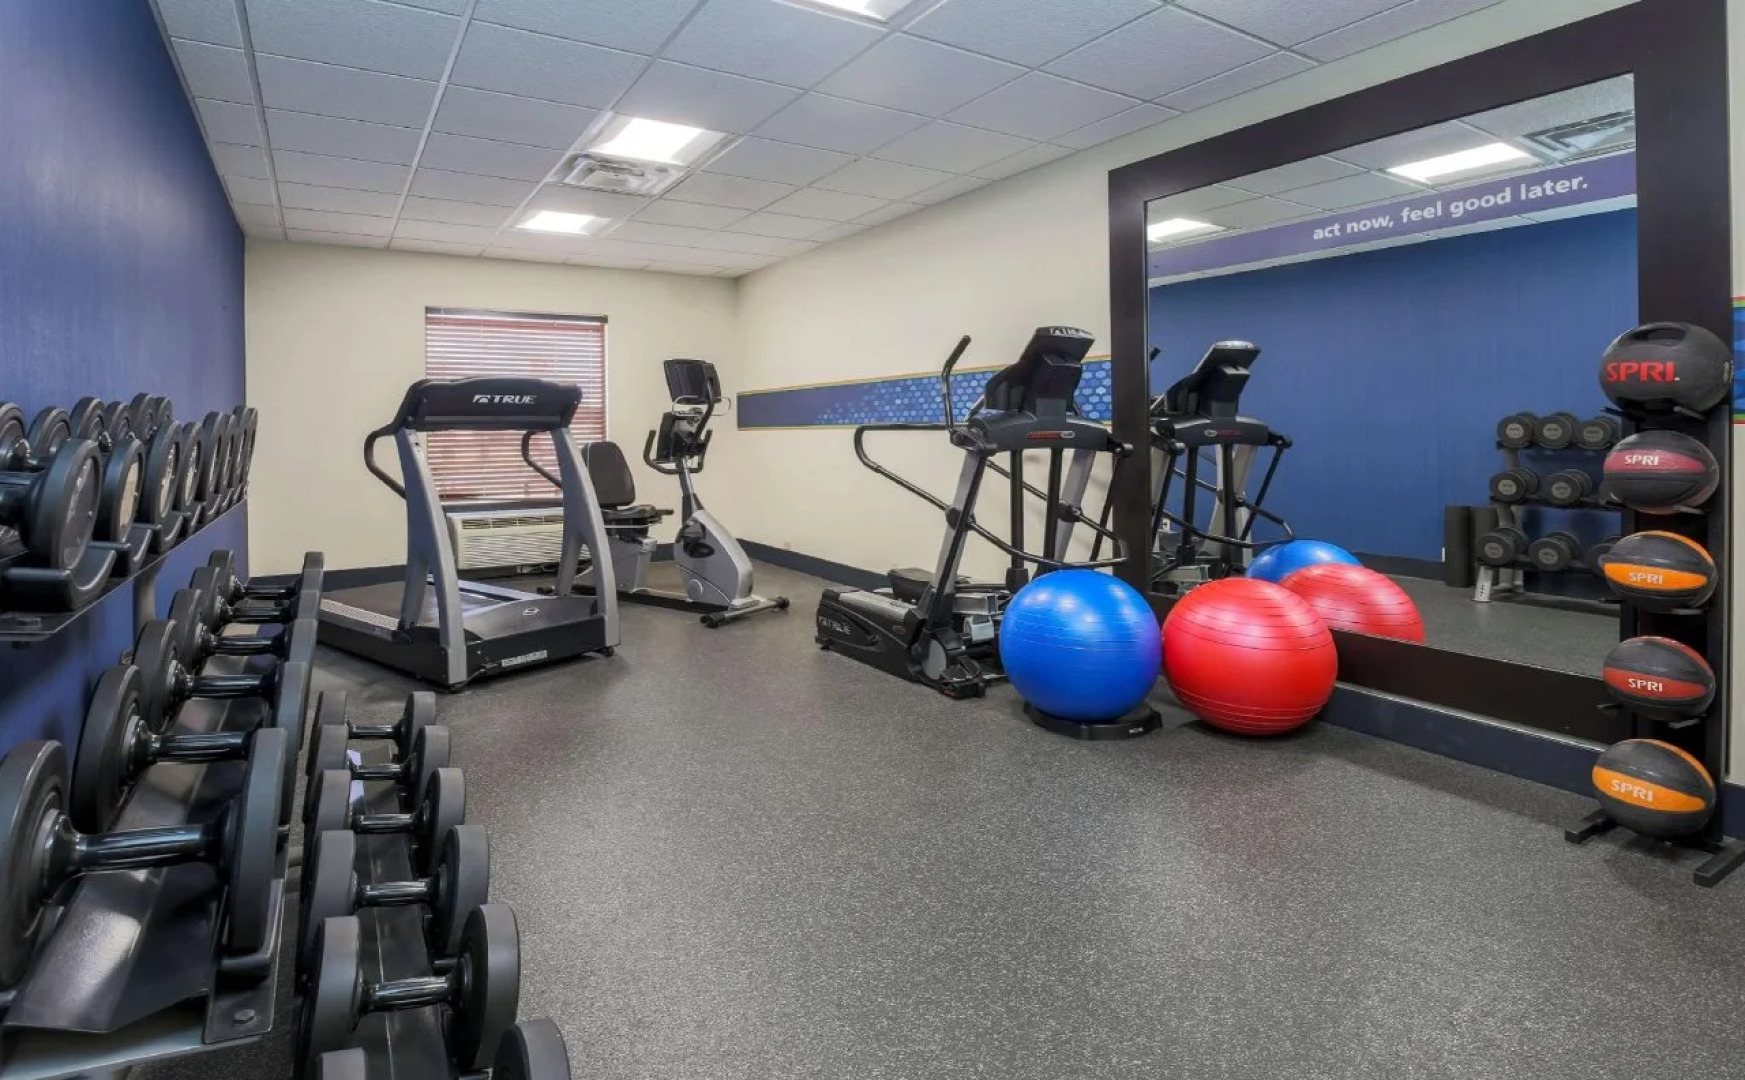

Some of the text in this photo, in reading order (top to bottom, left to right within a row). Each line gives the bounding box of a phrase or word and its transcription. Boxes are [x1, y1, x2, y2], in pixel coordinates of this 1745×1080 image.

[1313, 176, 1588, 240] act now, feel good later.
[492, 394, 537, 404] TRUE
[1624, 454, 1659, 466] SPRI
[1629, 572, 1663, 585] SPRI
[1628, 678, 1663, 692] SPRI
[1611, 779, 1653, 802] SPRI
